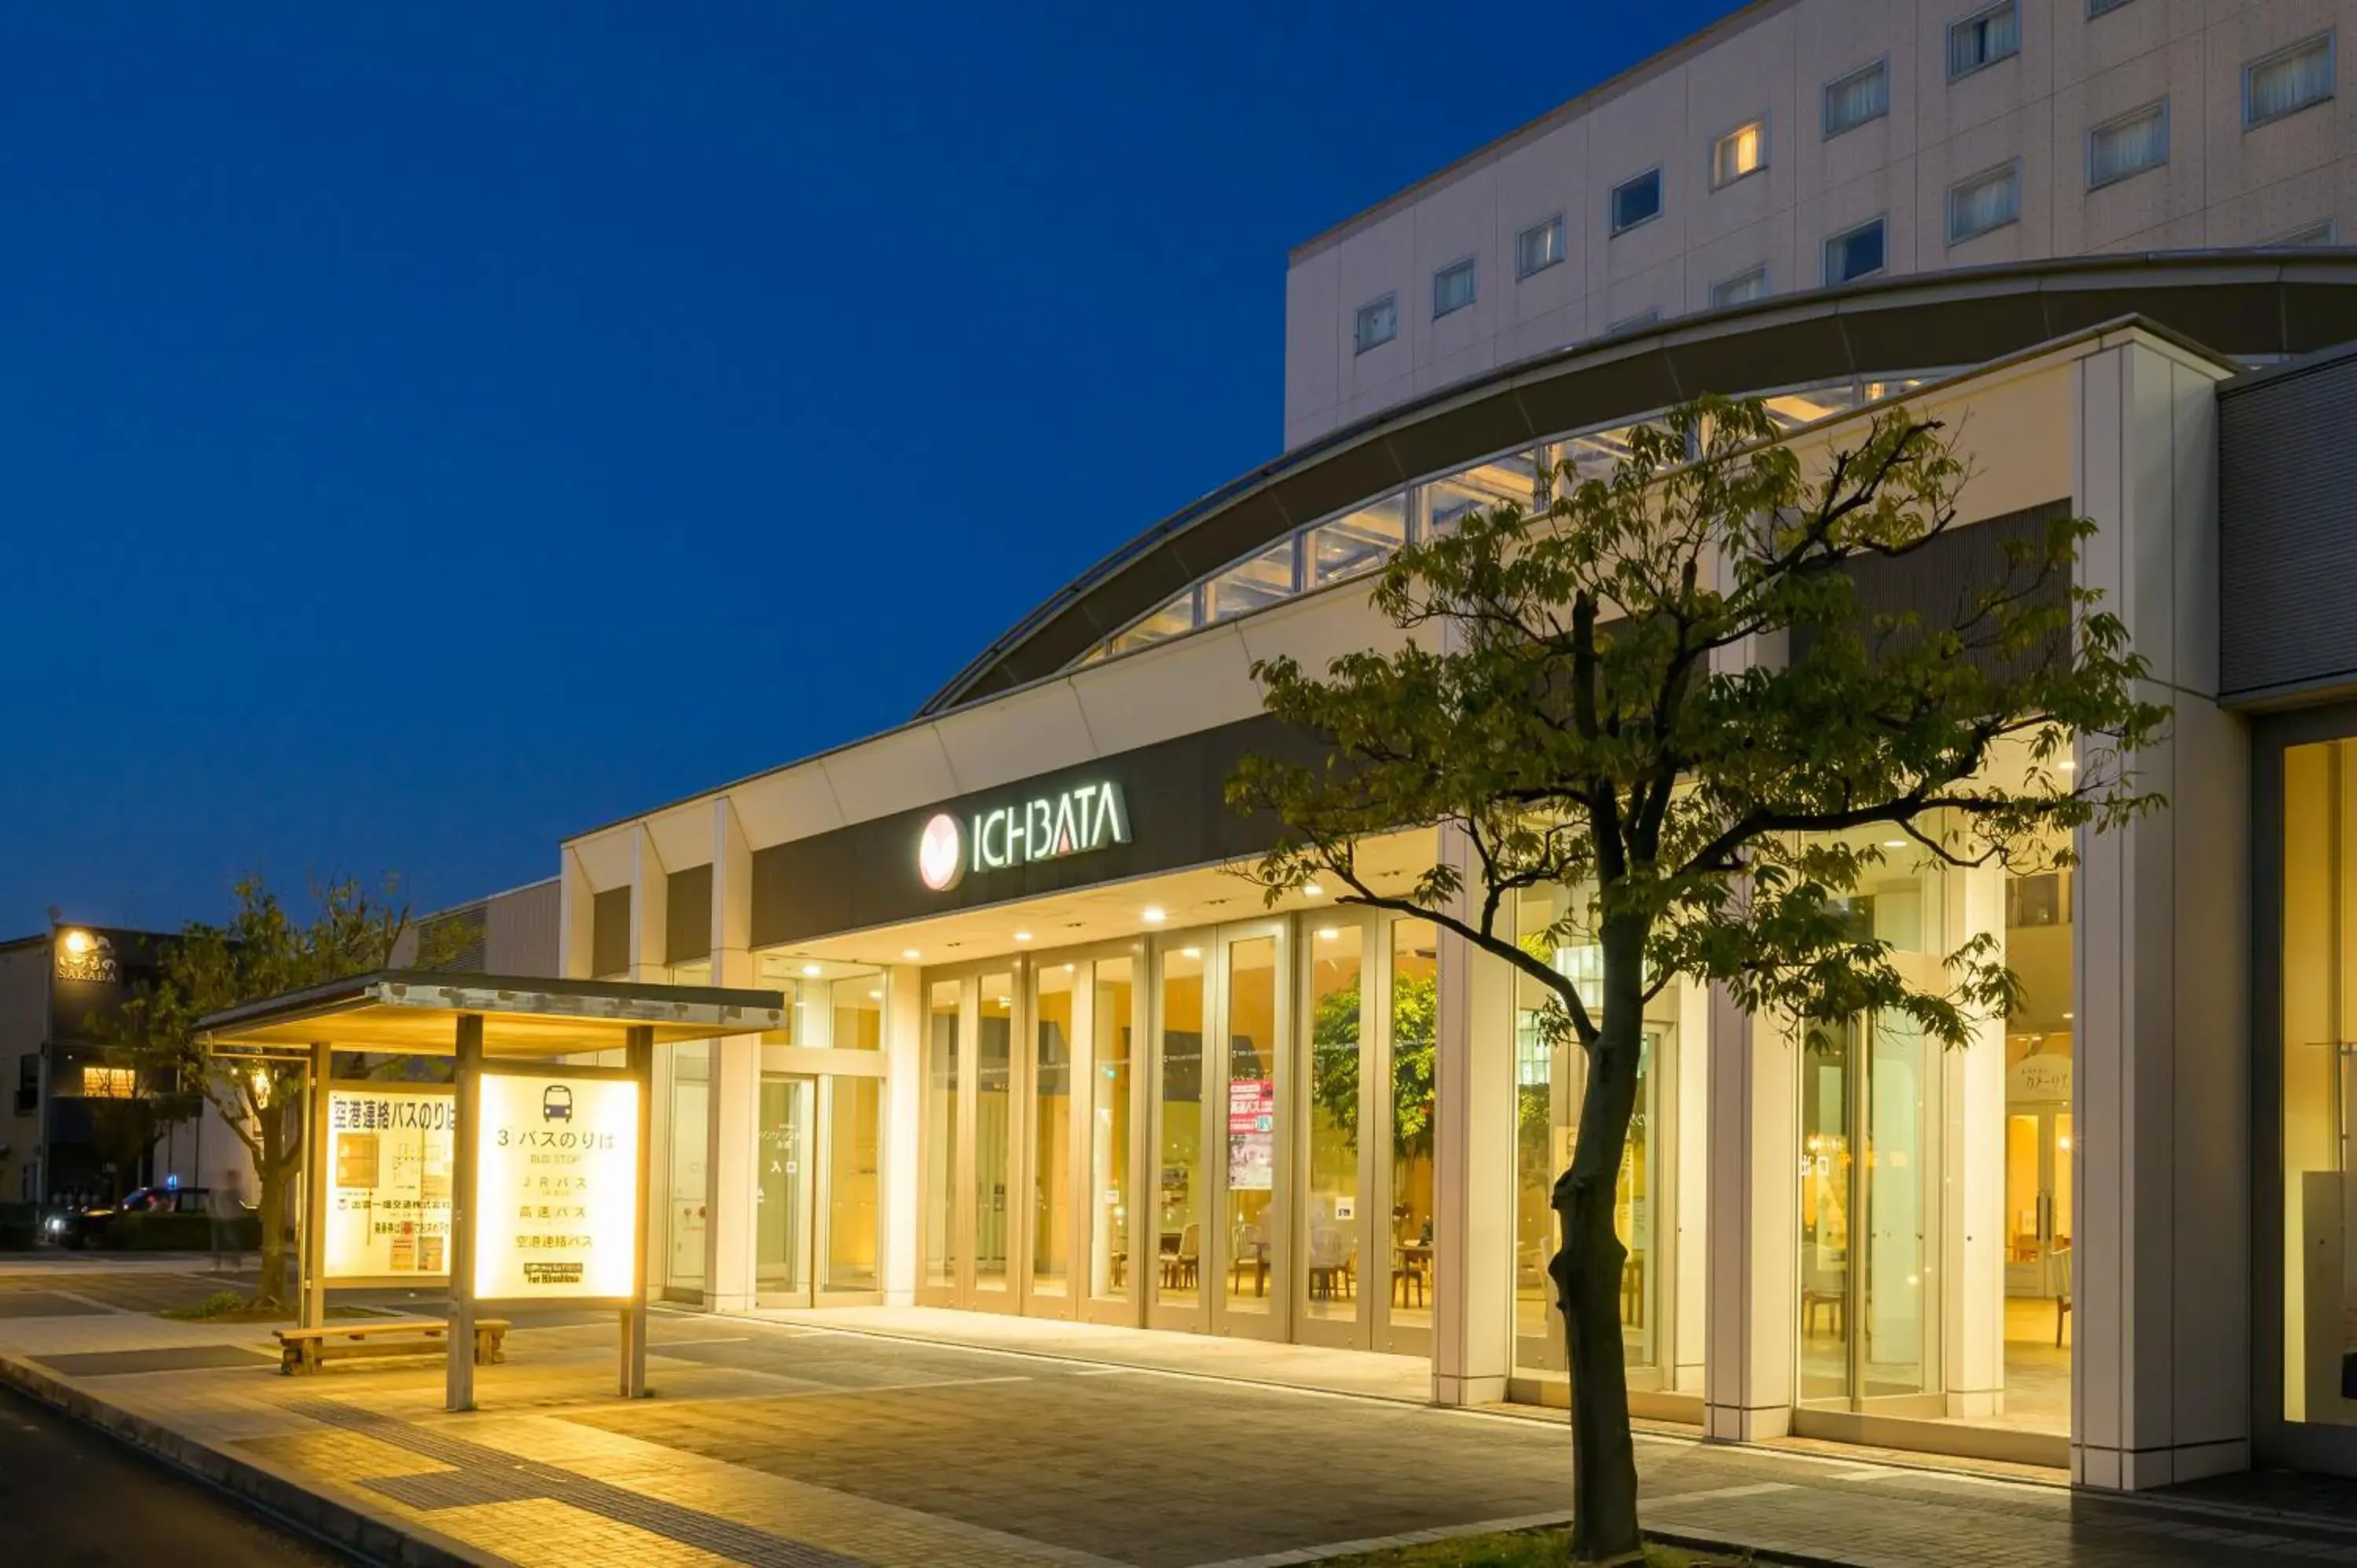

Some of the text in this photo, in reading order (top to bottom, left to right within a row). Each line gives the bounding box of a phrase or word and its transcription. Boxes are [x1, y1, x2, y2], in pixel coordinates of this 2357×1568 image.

[497, 1129, 508, 1146] 3
[771, 1160, 797, 1174] 入口
[1801, 1155, 1829, 1177] 出口
